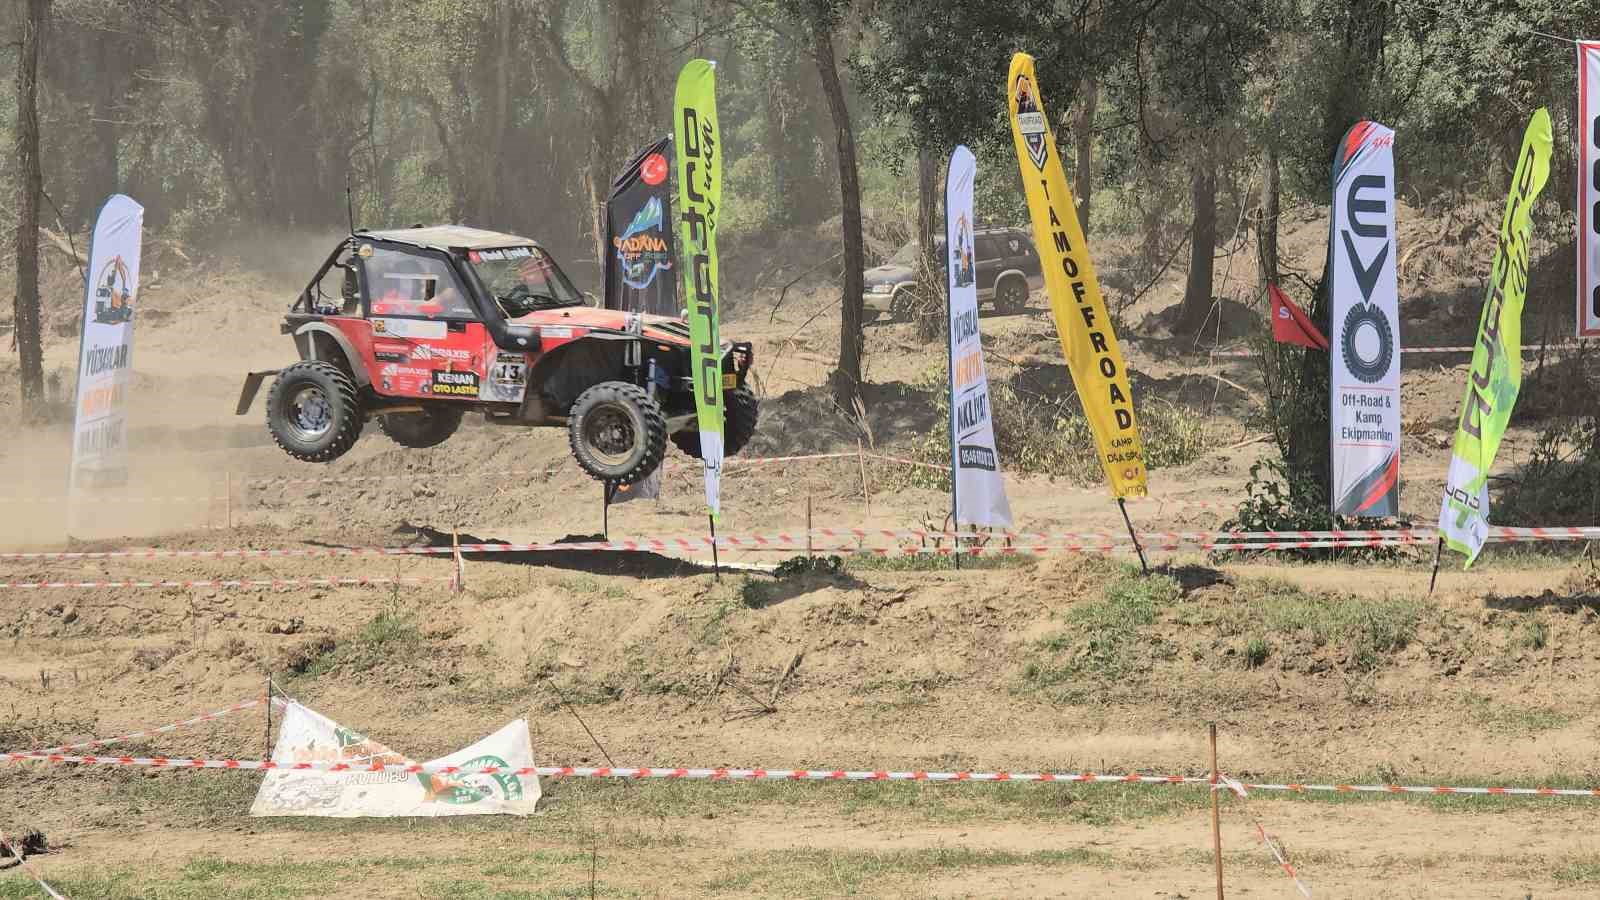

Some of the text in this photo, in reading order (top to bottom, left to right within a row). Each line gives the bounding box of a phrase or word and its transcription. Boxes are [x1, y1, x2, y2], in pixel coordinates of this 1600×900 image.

[1041, 179, 1132, 431] TAMOFFROAD
[437, 372, 474, 385] KENAN
[432, 384, 450, 393] OTO
[1342, 393, 1392, 408] Off-Road &
[1355, 411, 1383, 427] Kamp
[1341, 427, 1393, 442] Ekipmanları
